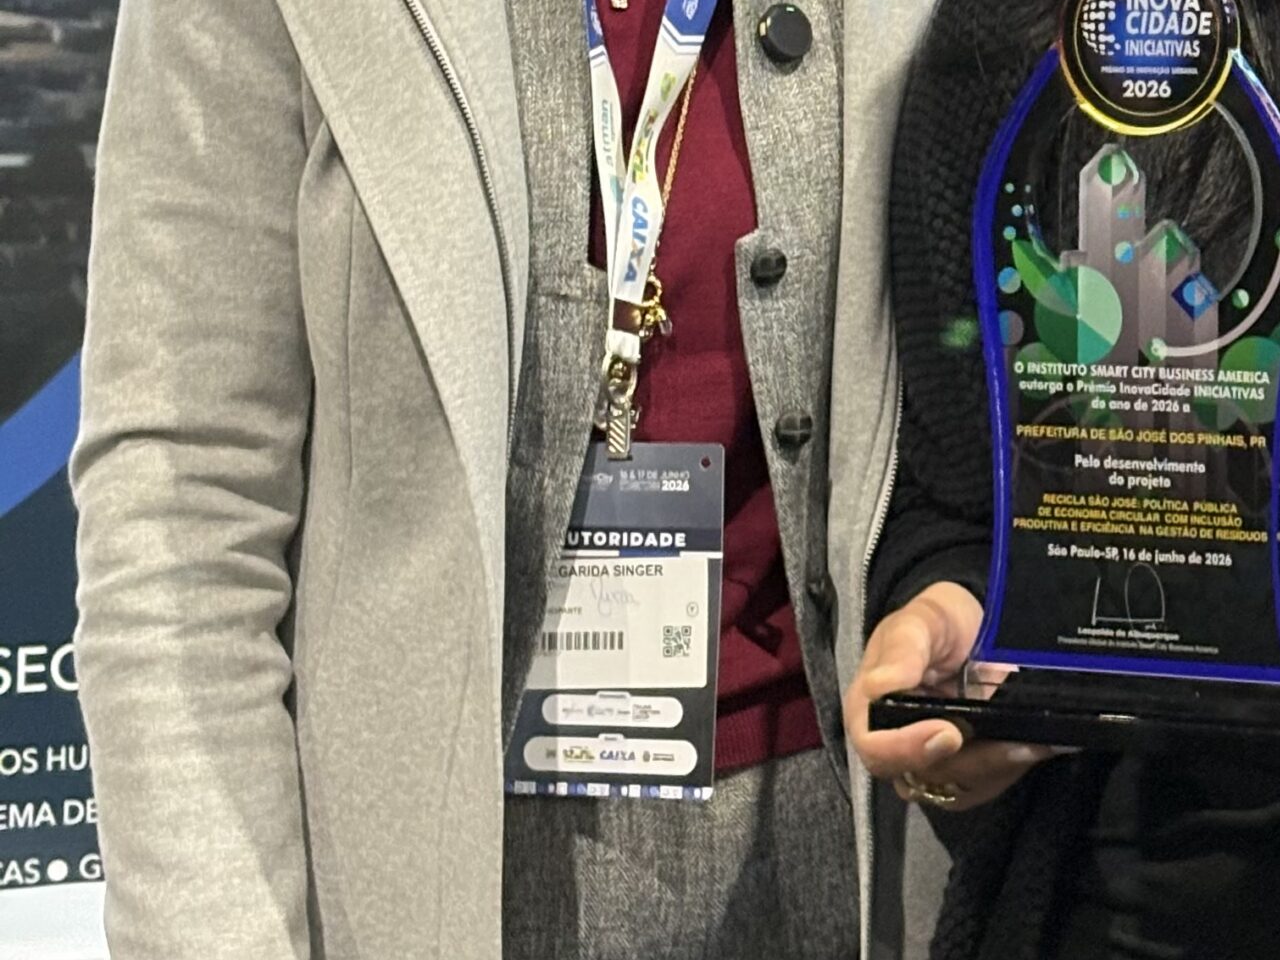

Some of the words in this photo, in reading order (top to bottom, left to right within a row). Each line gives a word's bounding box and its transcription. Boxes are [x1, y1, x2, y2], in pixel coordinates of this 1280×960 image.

[1125, 11, 1213, 35] CIDADE
[1125, 39, 1200, 57] INICIATIVAS
[1122, 79, 1172, 98] 2026
[624, 195, 648, 282] CAIXA
[1014, 362, 1024, 374] O
[1027, 362, 1087, 376] INSTITUTO
[1091, 365, 1128, 378] SMART
[1131, 366, 1157, 379] CITY
[1159, 367, 1214, 382] BUSINESS
[1217, 370, 1270, 384] AMERICA
[1120, 382, 1191, 397] InovaCidade
[1194, 385, 1265, 400] INICIATIVAS
[1109, 400, 1130, 410] ano
[1134, 399, 1148, 410] de
[1151, 400, 1179, 412] 2026
[1016, 425, 1088, 439] PREFEITURA
[1090, 428, 1106, 440] DE
[1109, 427, 1133, 441] SÃO
[1136, 429, 1166, 443] JOSÉ
[1170, 432, 1194, 444] DOS
[1250, 435, 1267, 447] PR
[1075, 454, 1100, 468] Pelo
[1103, 455, 1206, 473] desenvolvimento
[661, 480, 690, 492] 2026
[1109, 472, 1124, 485] do
[1128, 473, 1171, 489] projeto
[1043, 494, 1086, 506] RECICLA
[1088, 494, 1110, 507] SÃO
[1143, 497, 1189, 511] POLÍTICA
[1038, 506, 1051, 517] DE
[1054, 507, 1107, 520] ECONOMIA
[1110, 510, 1160, 523] CIRCULAR
[1164, 513, 1188, 524] COM
[1190, 514, 1242, 527] INCLUSÃO
[1013, 518, 1069, 531] PRODUTIVA
[1139, 524, 1154, 535] NA
[1156, 524, 1197, 539] GESTÃO
[1200, 527, 1213, 539] DE
[1047, 543, 1067, 557] São
[1070, 545, 1119, 561] Paulo-SP,
[1123, 547, 1135, 560] 16
[1138, 547, 1152, 561] de
[1154, 549, 1185, 565] junho
[1188, 550, 1202, 564] de
[1205, 552, 1232, 566] 2026
[613, 564, 664, 577] SINGER
[46, 744, 88, 771] HU
[599, 750, 636, 762] CAIXA
[63, 798, 99, 826] DE
[0, 858, 40, 886] AS
